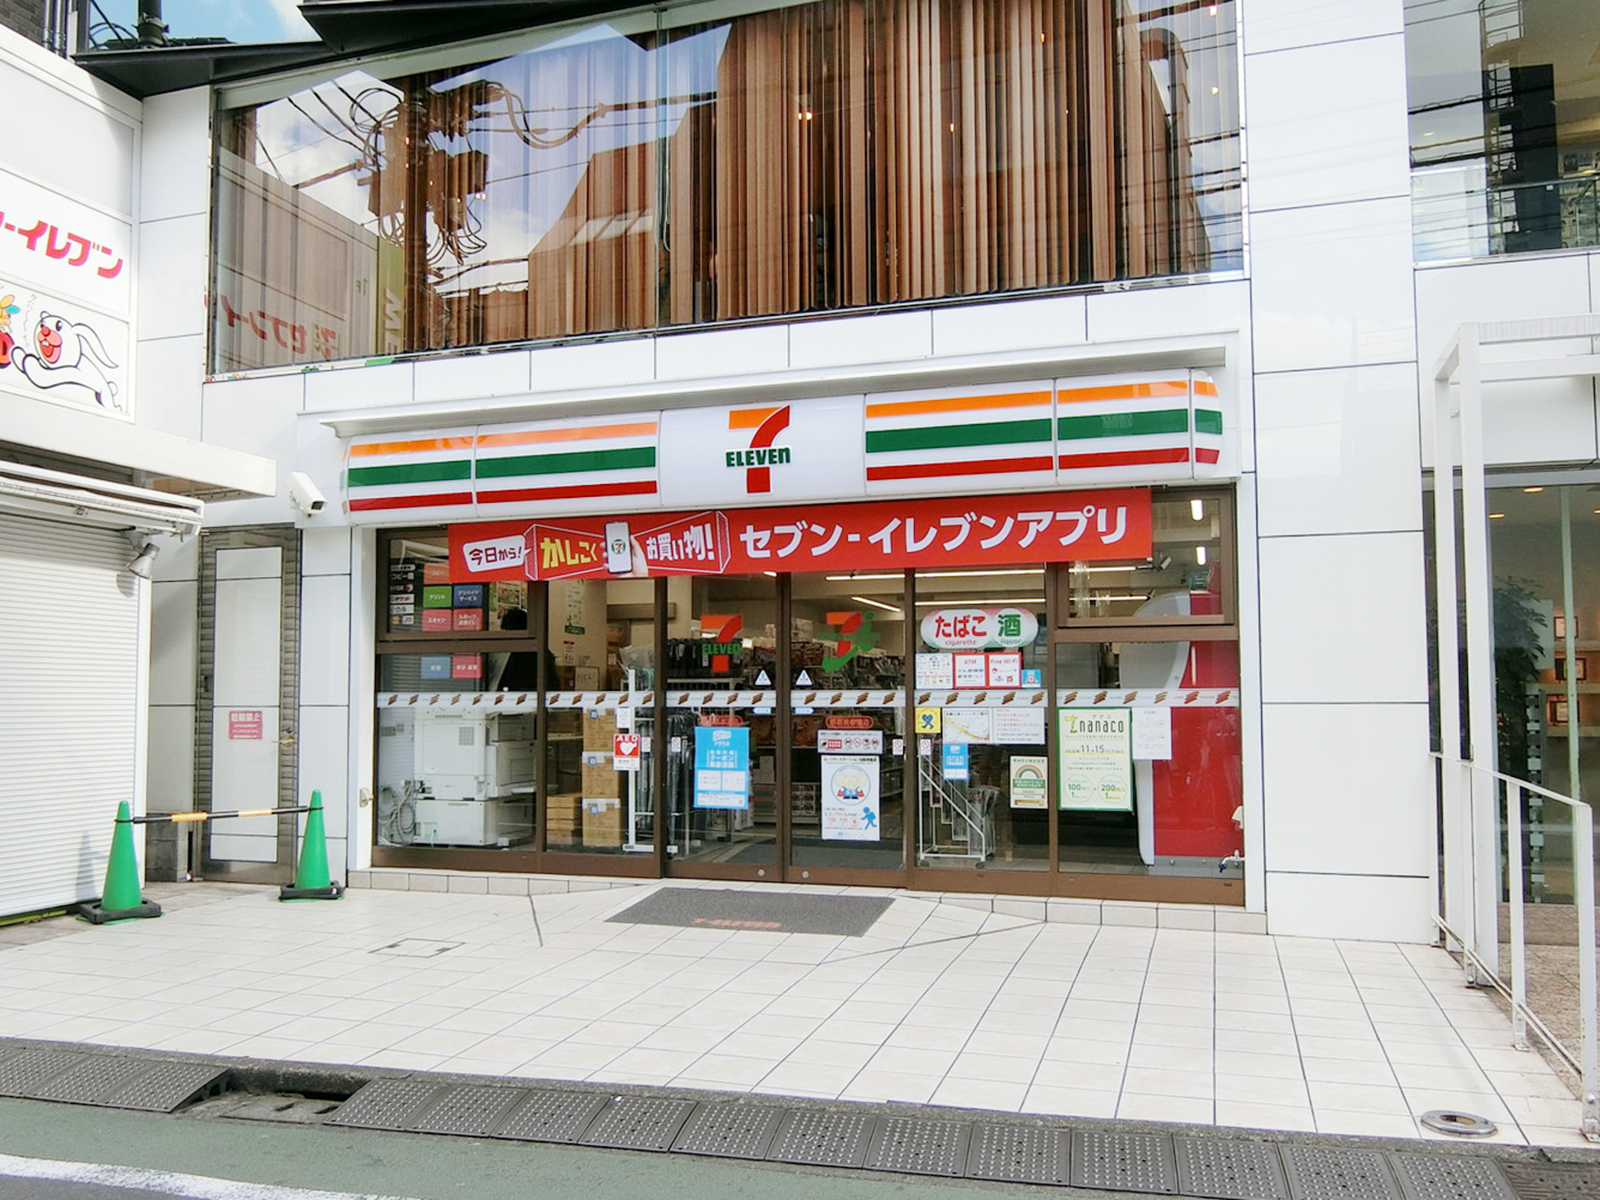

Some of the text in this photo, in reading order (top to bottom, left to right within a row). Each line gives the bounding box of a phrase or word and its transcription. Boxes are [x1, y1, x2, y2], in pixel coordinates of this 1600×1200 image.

[0, 211, 123, 279] -イレブン
[728, 405, 790, 494] 7
[468, 545, 522, 566] 今日から!
[540, 537, 598, 569] かしこく
[646, 523, 715, 561] お買い物!
[935, 614, 1021, 638] たばこ 酒
[1079, 720, 1124, 733] nanaco
